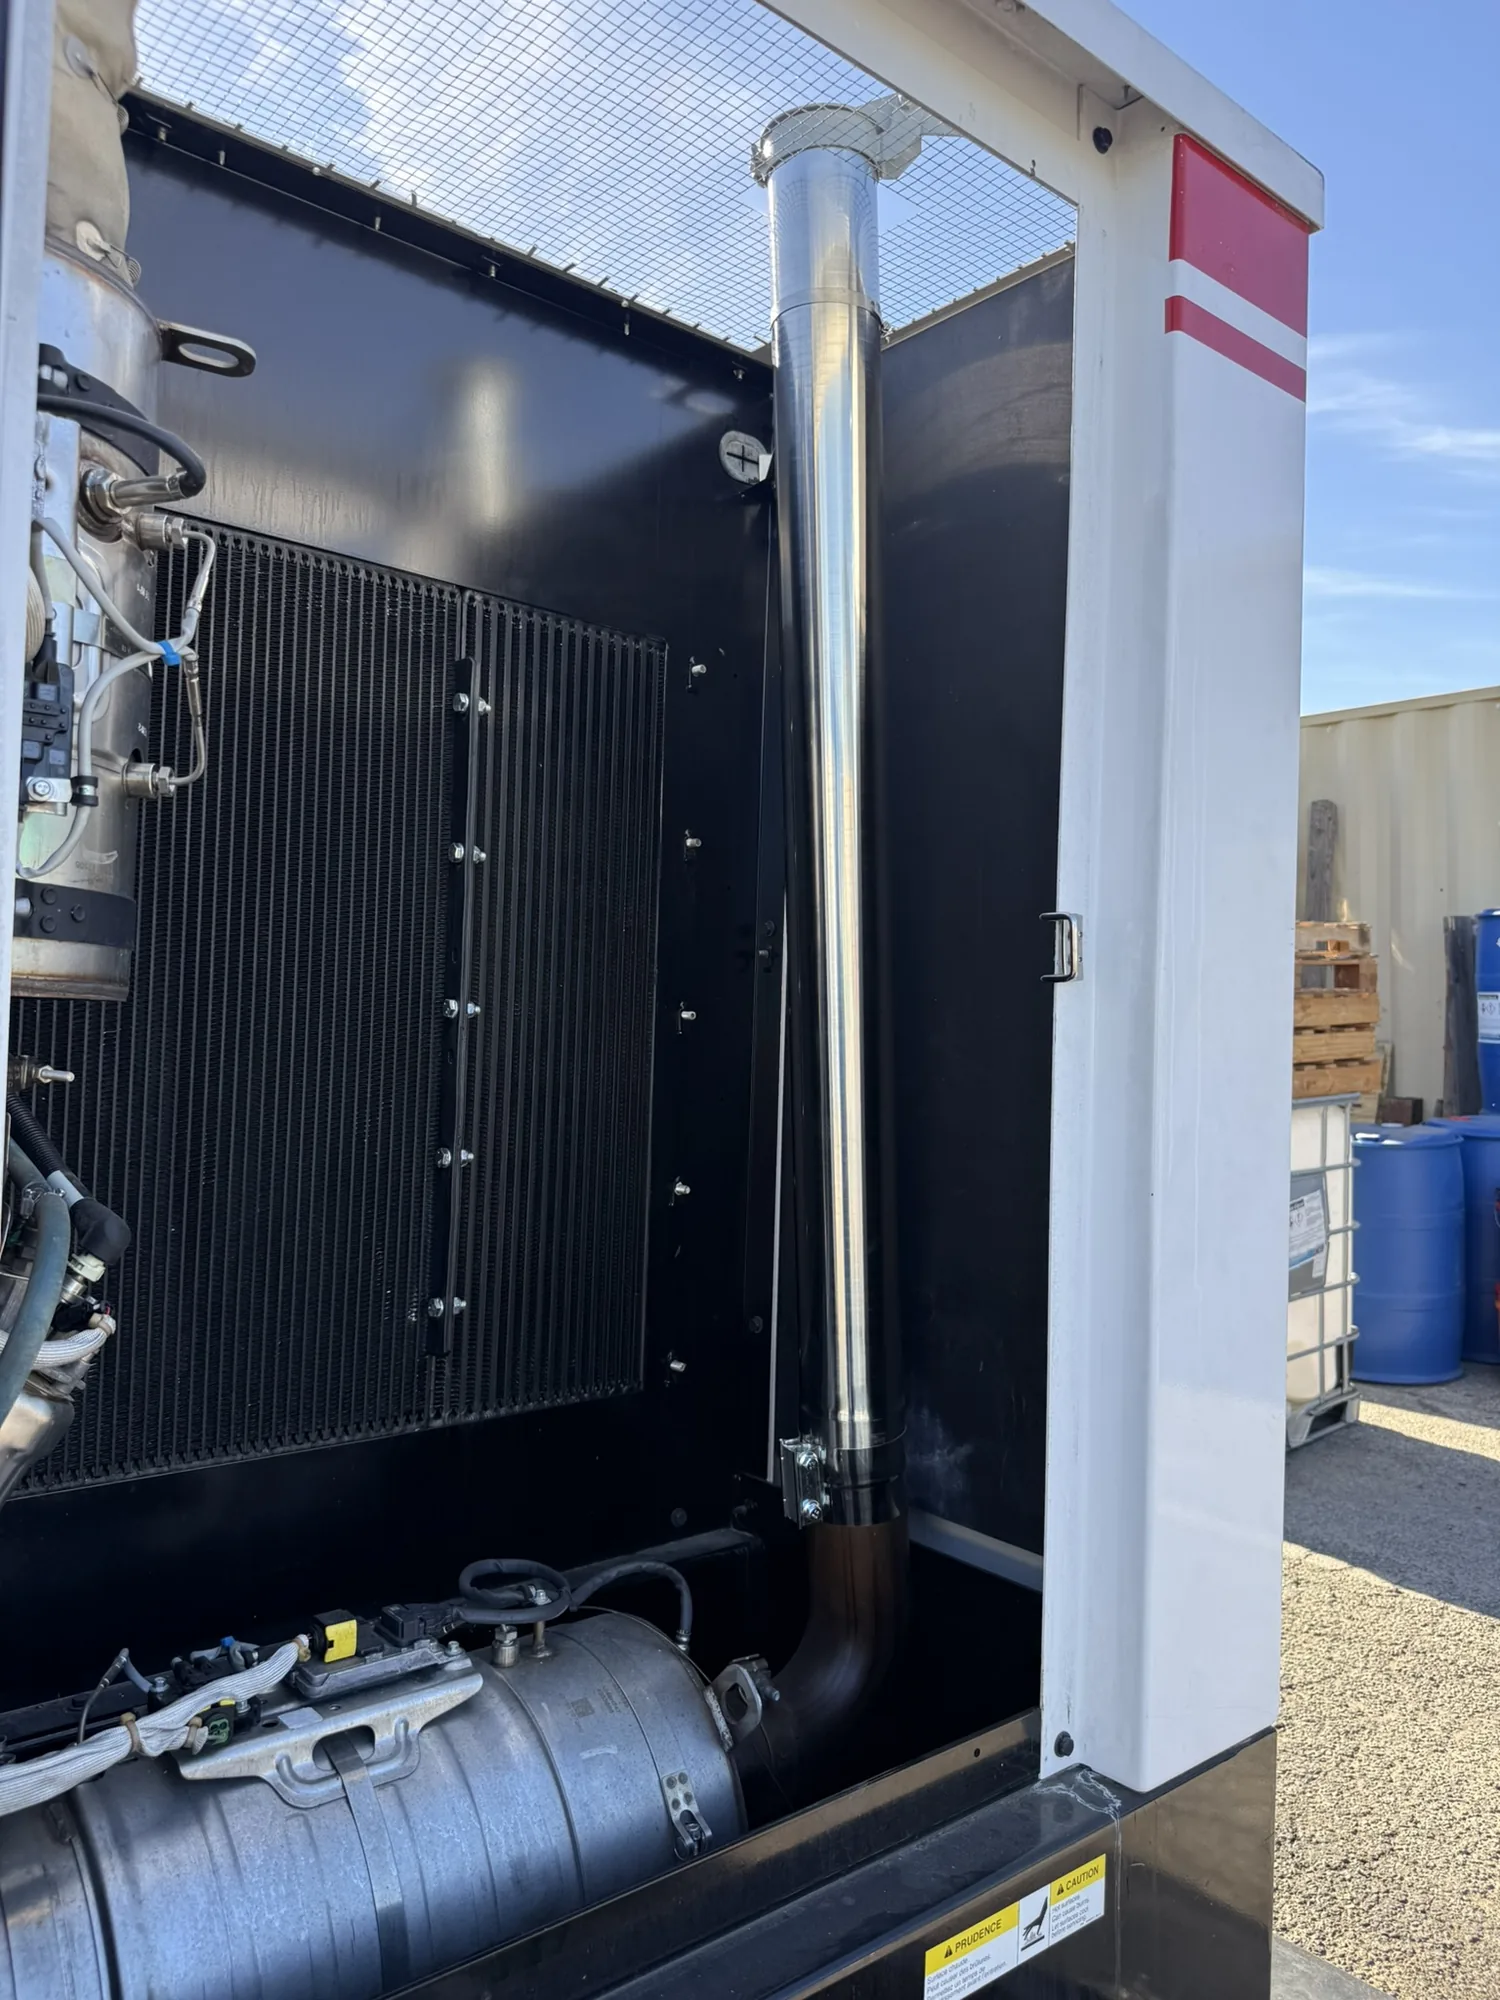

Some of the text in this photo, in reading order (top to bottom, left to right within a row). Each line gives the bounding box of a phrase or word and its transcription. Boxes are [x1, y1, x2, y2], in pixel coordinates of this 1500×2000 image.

[1066, 1865, 1099, 1890] CAUTION
[1060, 1912, 1079, 1926] surfaces
[955, 1919, 1002, 1952] PRUDENCE
[927, 1968, 947, 1985] Surface
[927, 1981, 939, 1994] Peut
[940, 1972, 957, 1987] causer
[958, 1965, 969, 1977] des
